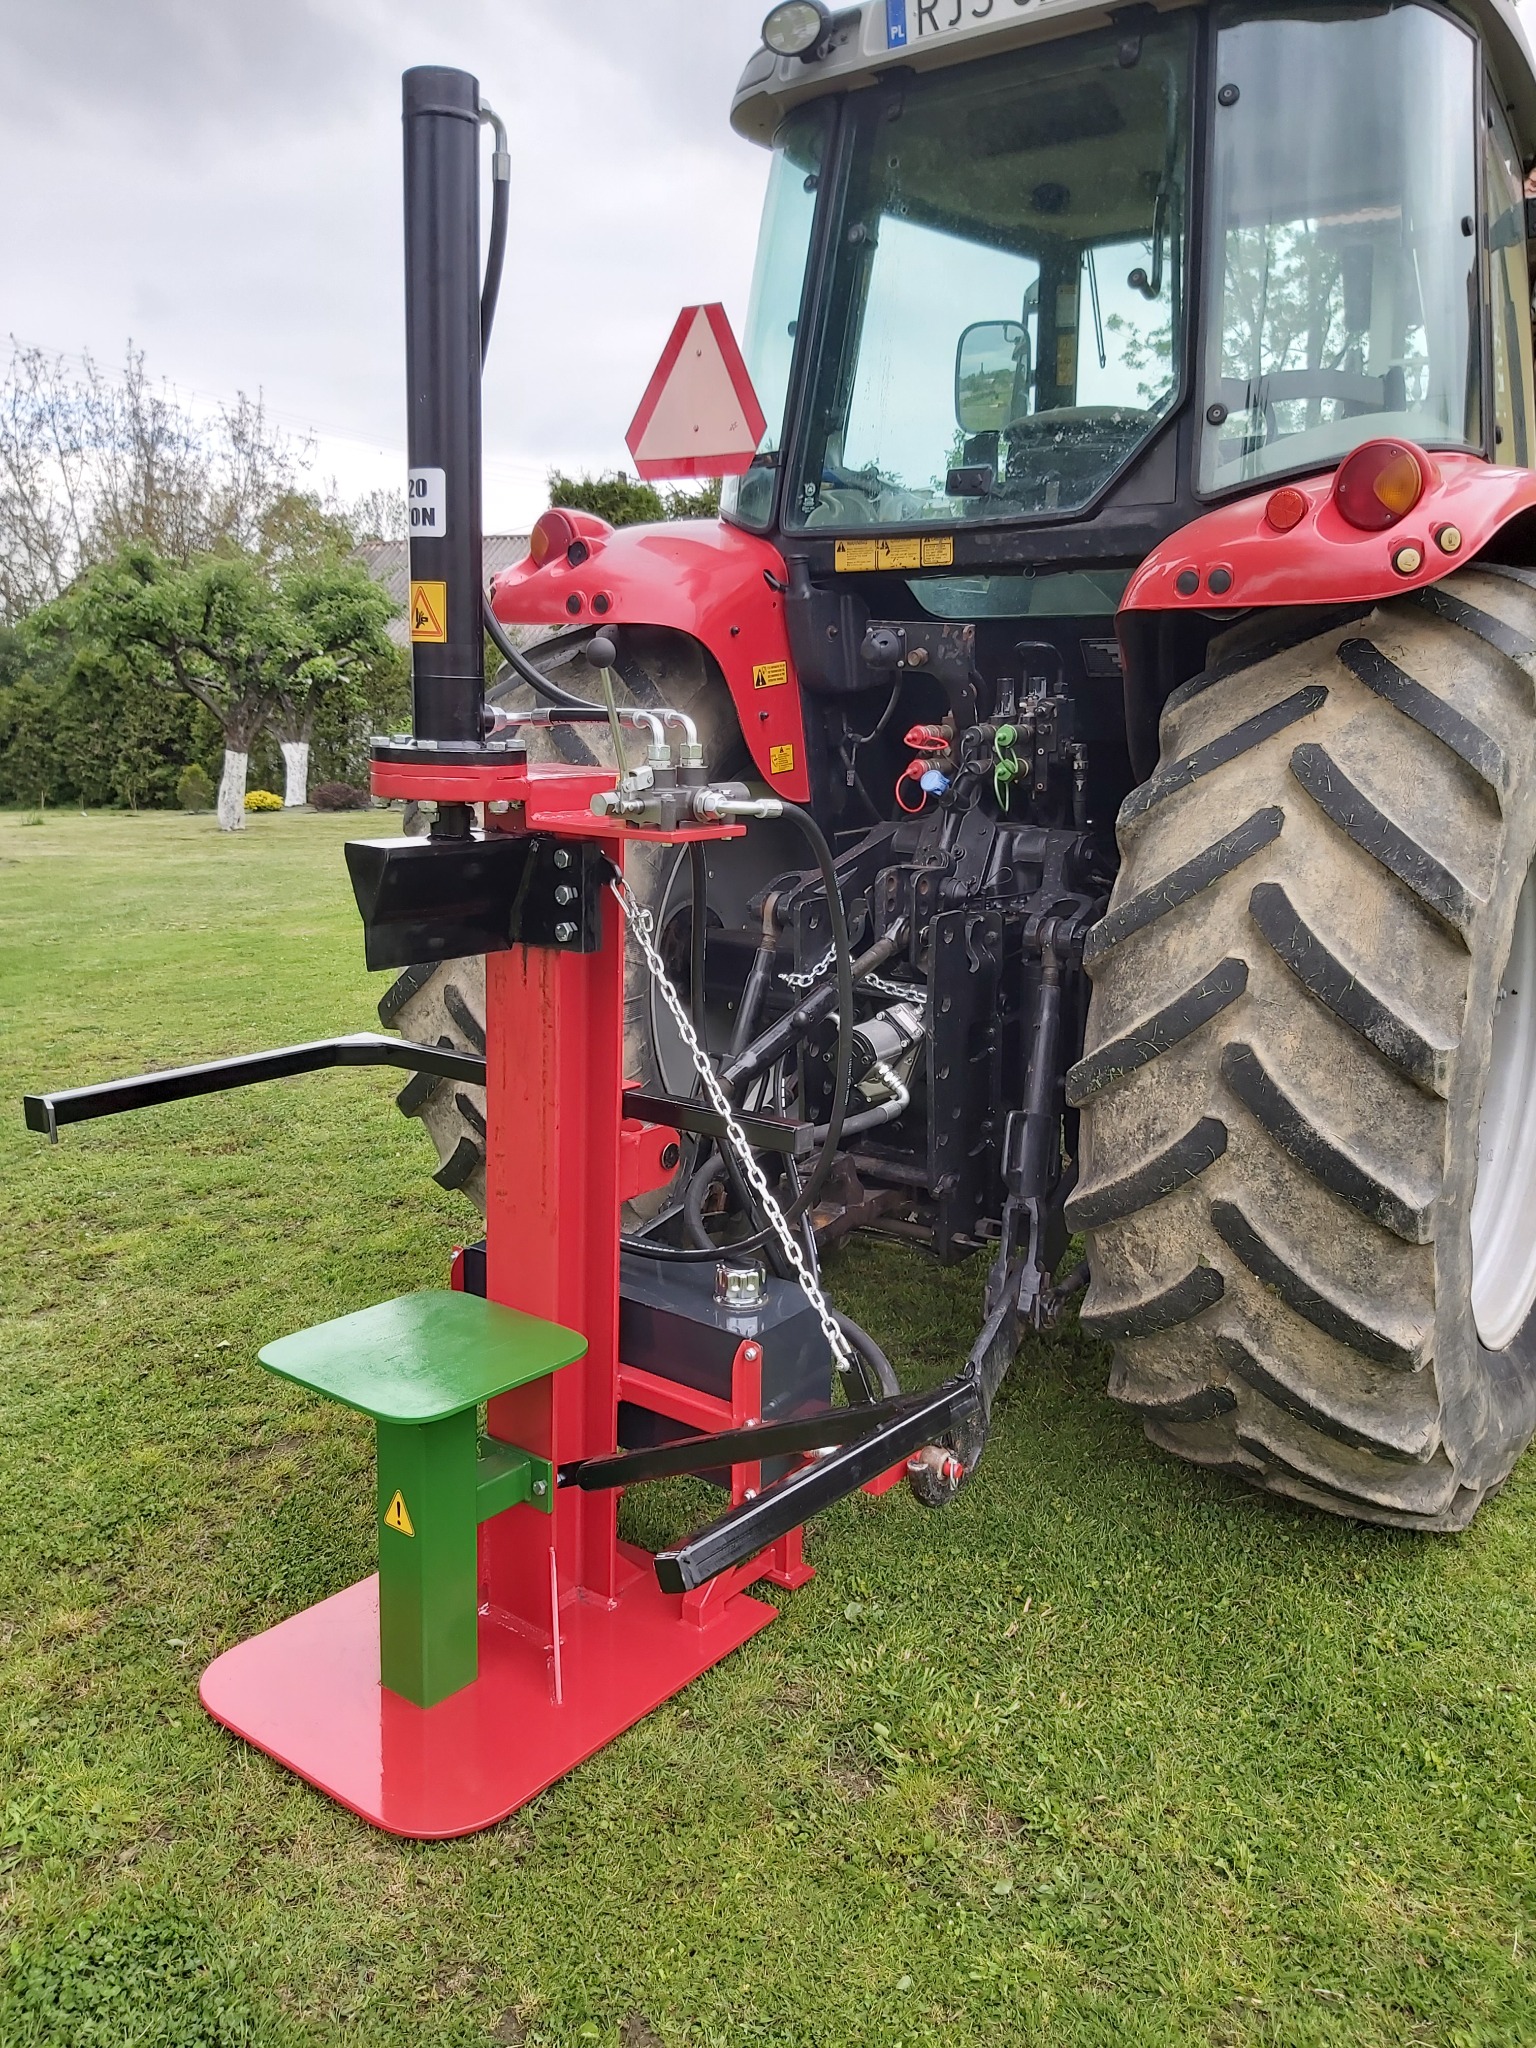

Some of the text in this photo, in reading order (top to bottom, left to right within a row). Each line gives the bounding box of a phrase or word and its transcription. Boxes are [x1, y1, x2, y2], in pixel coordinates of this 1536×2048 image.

[890, 25, 905, 40] PL
[408, 478, 427, 498] 20
[409, 507, 435, 526] ON
